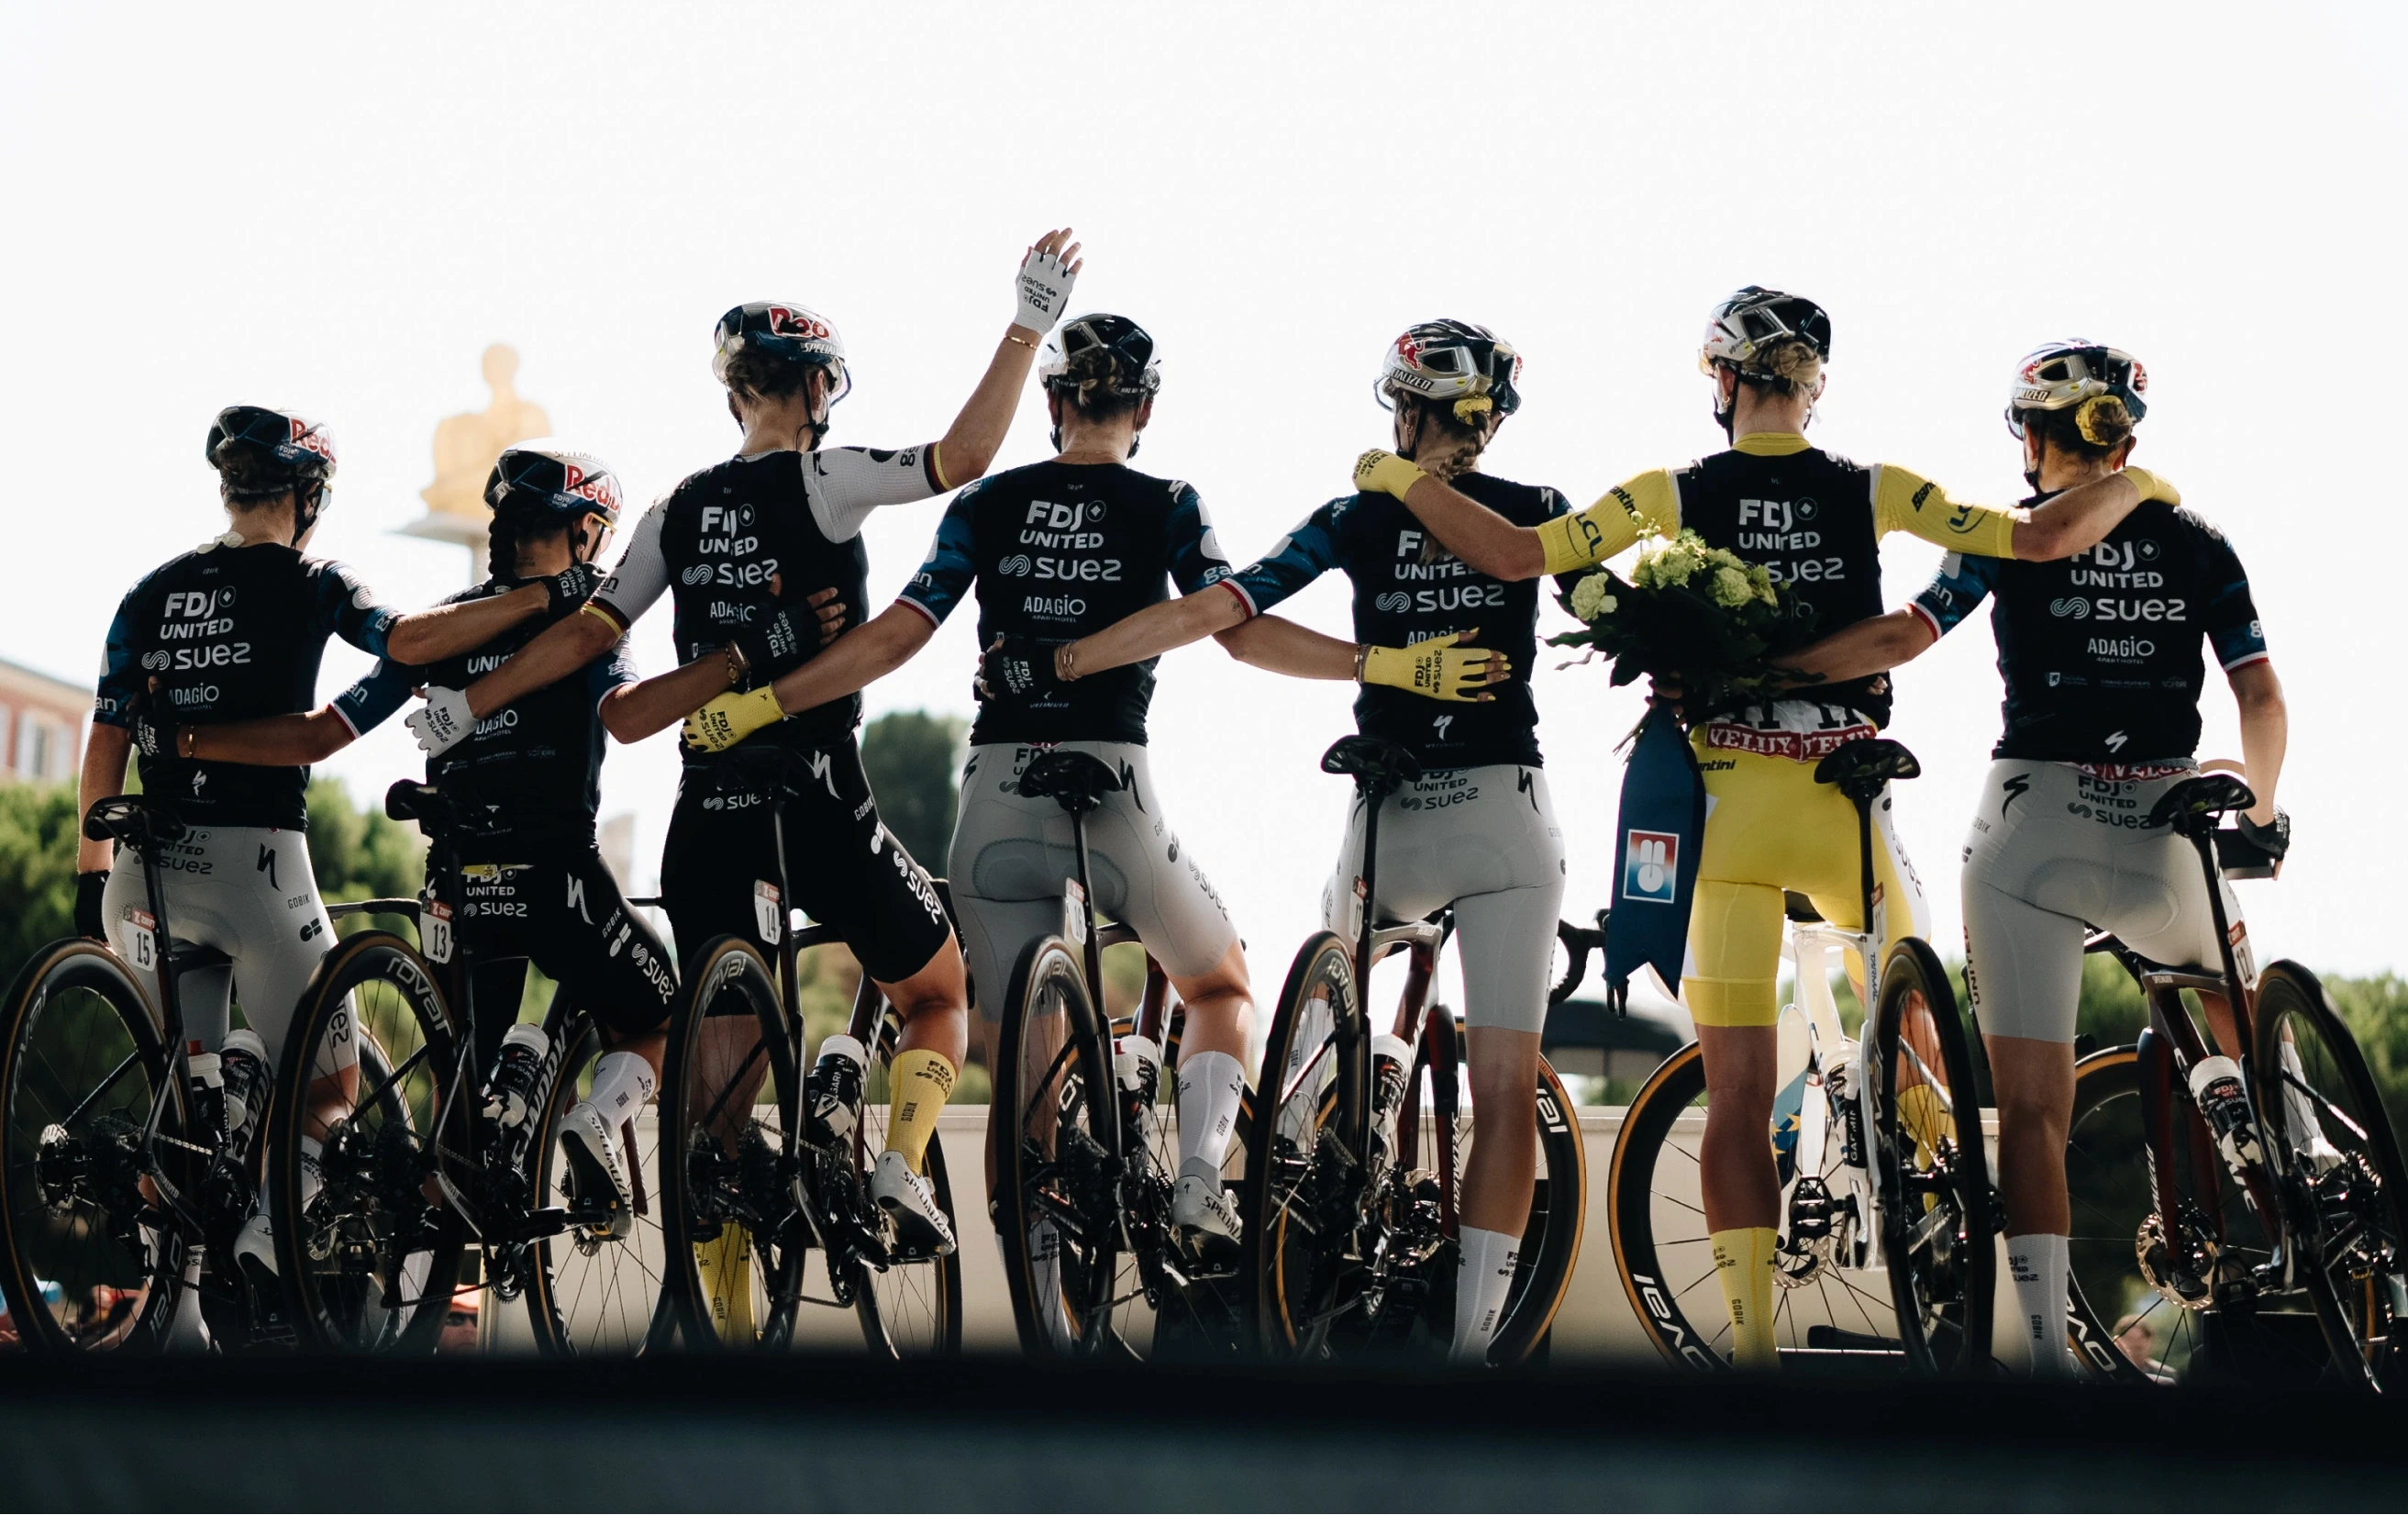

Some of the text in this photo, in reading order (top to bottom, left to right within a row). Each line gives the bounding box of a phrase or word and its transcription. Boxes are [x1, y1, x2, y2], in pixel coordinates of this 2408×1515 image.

[1024, 285, 1050, 304] UNITED
[1028, 295, 1049, 313] FDJ
[1026, 500, 1084, 532] FDJ
[1019, 529, 1104, 550] UNITED
[1574, 512, 1603, 558] LCL
[2070, 569, 2164, 589] UNITED
[164, 589, 217, 619] FDJ
[160, 618, 235, 640] UNITED
[767, 633, 781, 658] FDJ
[1013, 661, 1026, 689] UNITED
[1019, 661, 1031, 683] FDJ
[1415, 664, 1425, 688] FDJ
[1424, 656, 1433, 688] UNITED
[439, 706, 455, 726] FDJ
[709, 712, 728, 741] UNITED
[716, 709, 731, 732] FDJ
[1414, 777, 1468, 792] UNITED
[2078, 775, 2120, 797] FDJ
[2079, 789, 2137, 809] UNITED
[287, 893, 311, 909] GOBIK
[466, 886, 516, 897] UNITED
[602, 907, 622, 938] GOBIK
[765, 905, 777, 940] 14
[136, 931, 150, 966] 15
[432, 923, 447, 959] 13
[386, 957, 453, 1038] roval
[901, 1102, 917, 1122] GOBIK
[1215, 1116, 1230, 1136] GOBIK
[1451, 1111, 1460, 1214] SPECIALIZED
[713, 1297, 727, 1320] GOBIK
[1731, 1298, 1744, 1325] GOBIK
[1481, 1309, 1497, 1332] GOBIK
[2031, 1314, 2042, 1340] GOBIK
